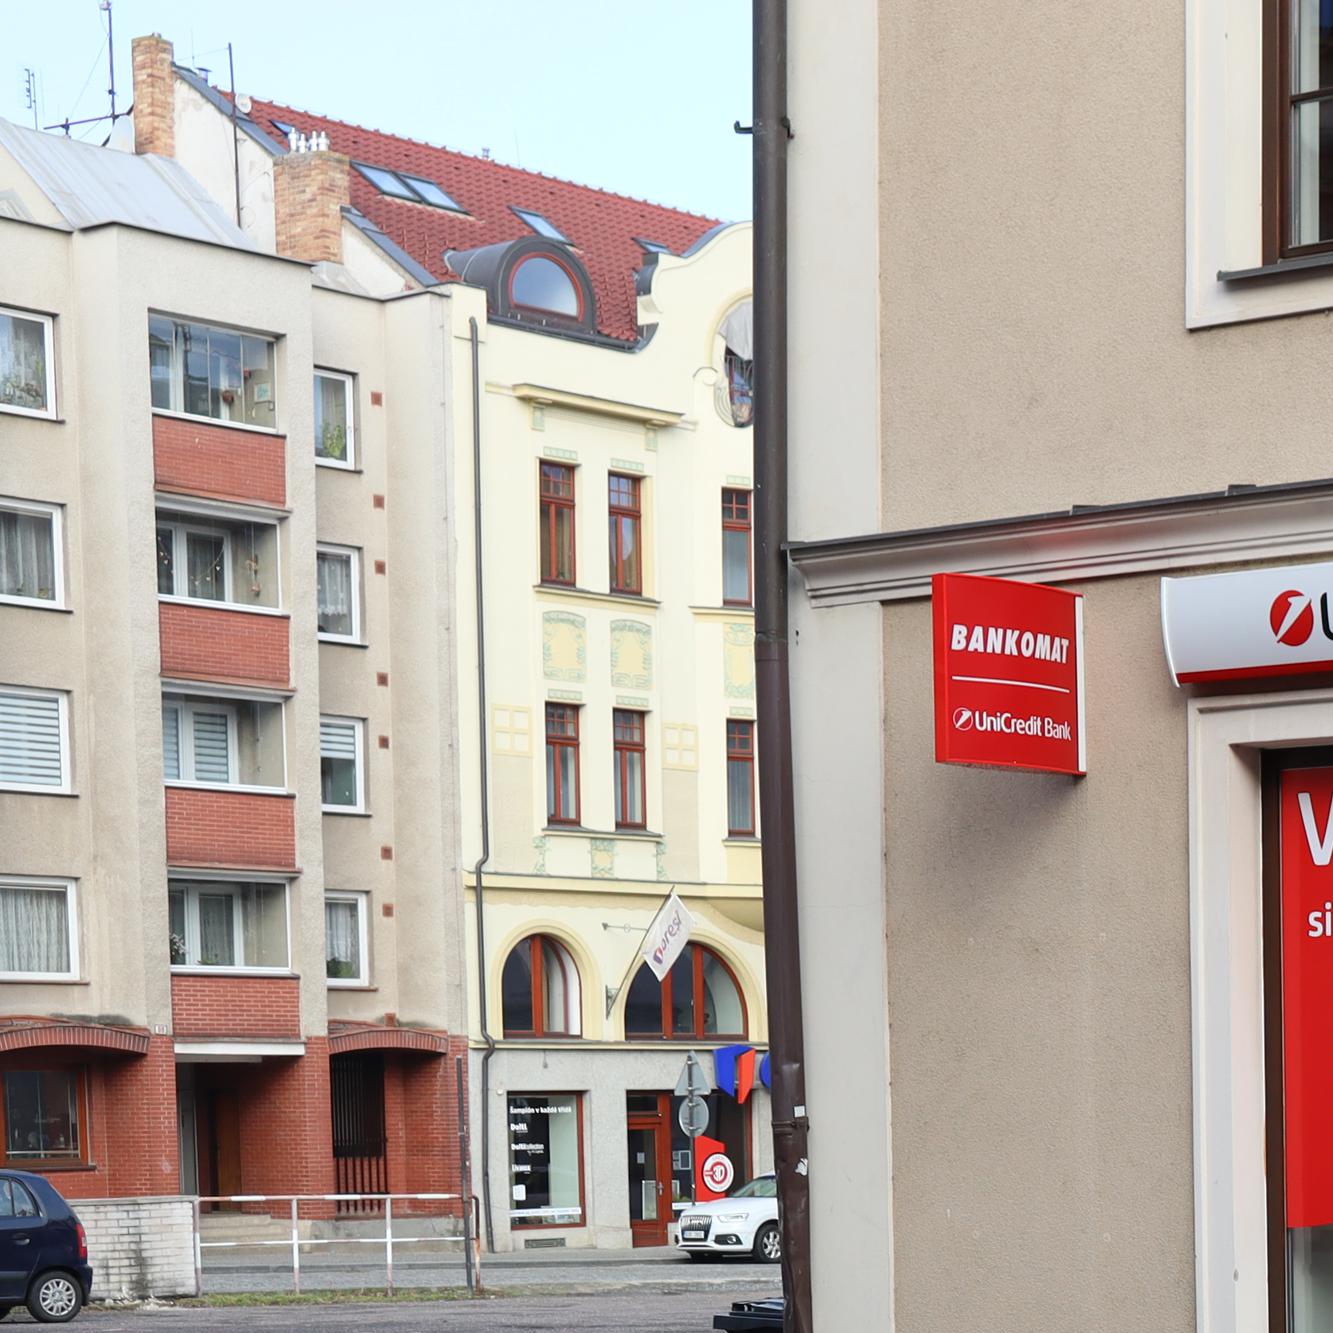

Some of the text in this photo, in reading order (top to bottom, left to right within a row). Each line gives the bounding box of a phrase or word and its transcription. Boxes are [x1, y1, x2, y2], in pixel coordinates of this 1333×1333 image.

[951, 623, 1070, 664] BANKOMAT
[974, 710, 1072, 741] UniCredit Bank
[1307, 902, 1333, 938] si
